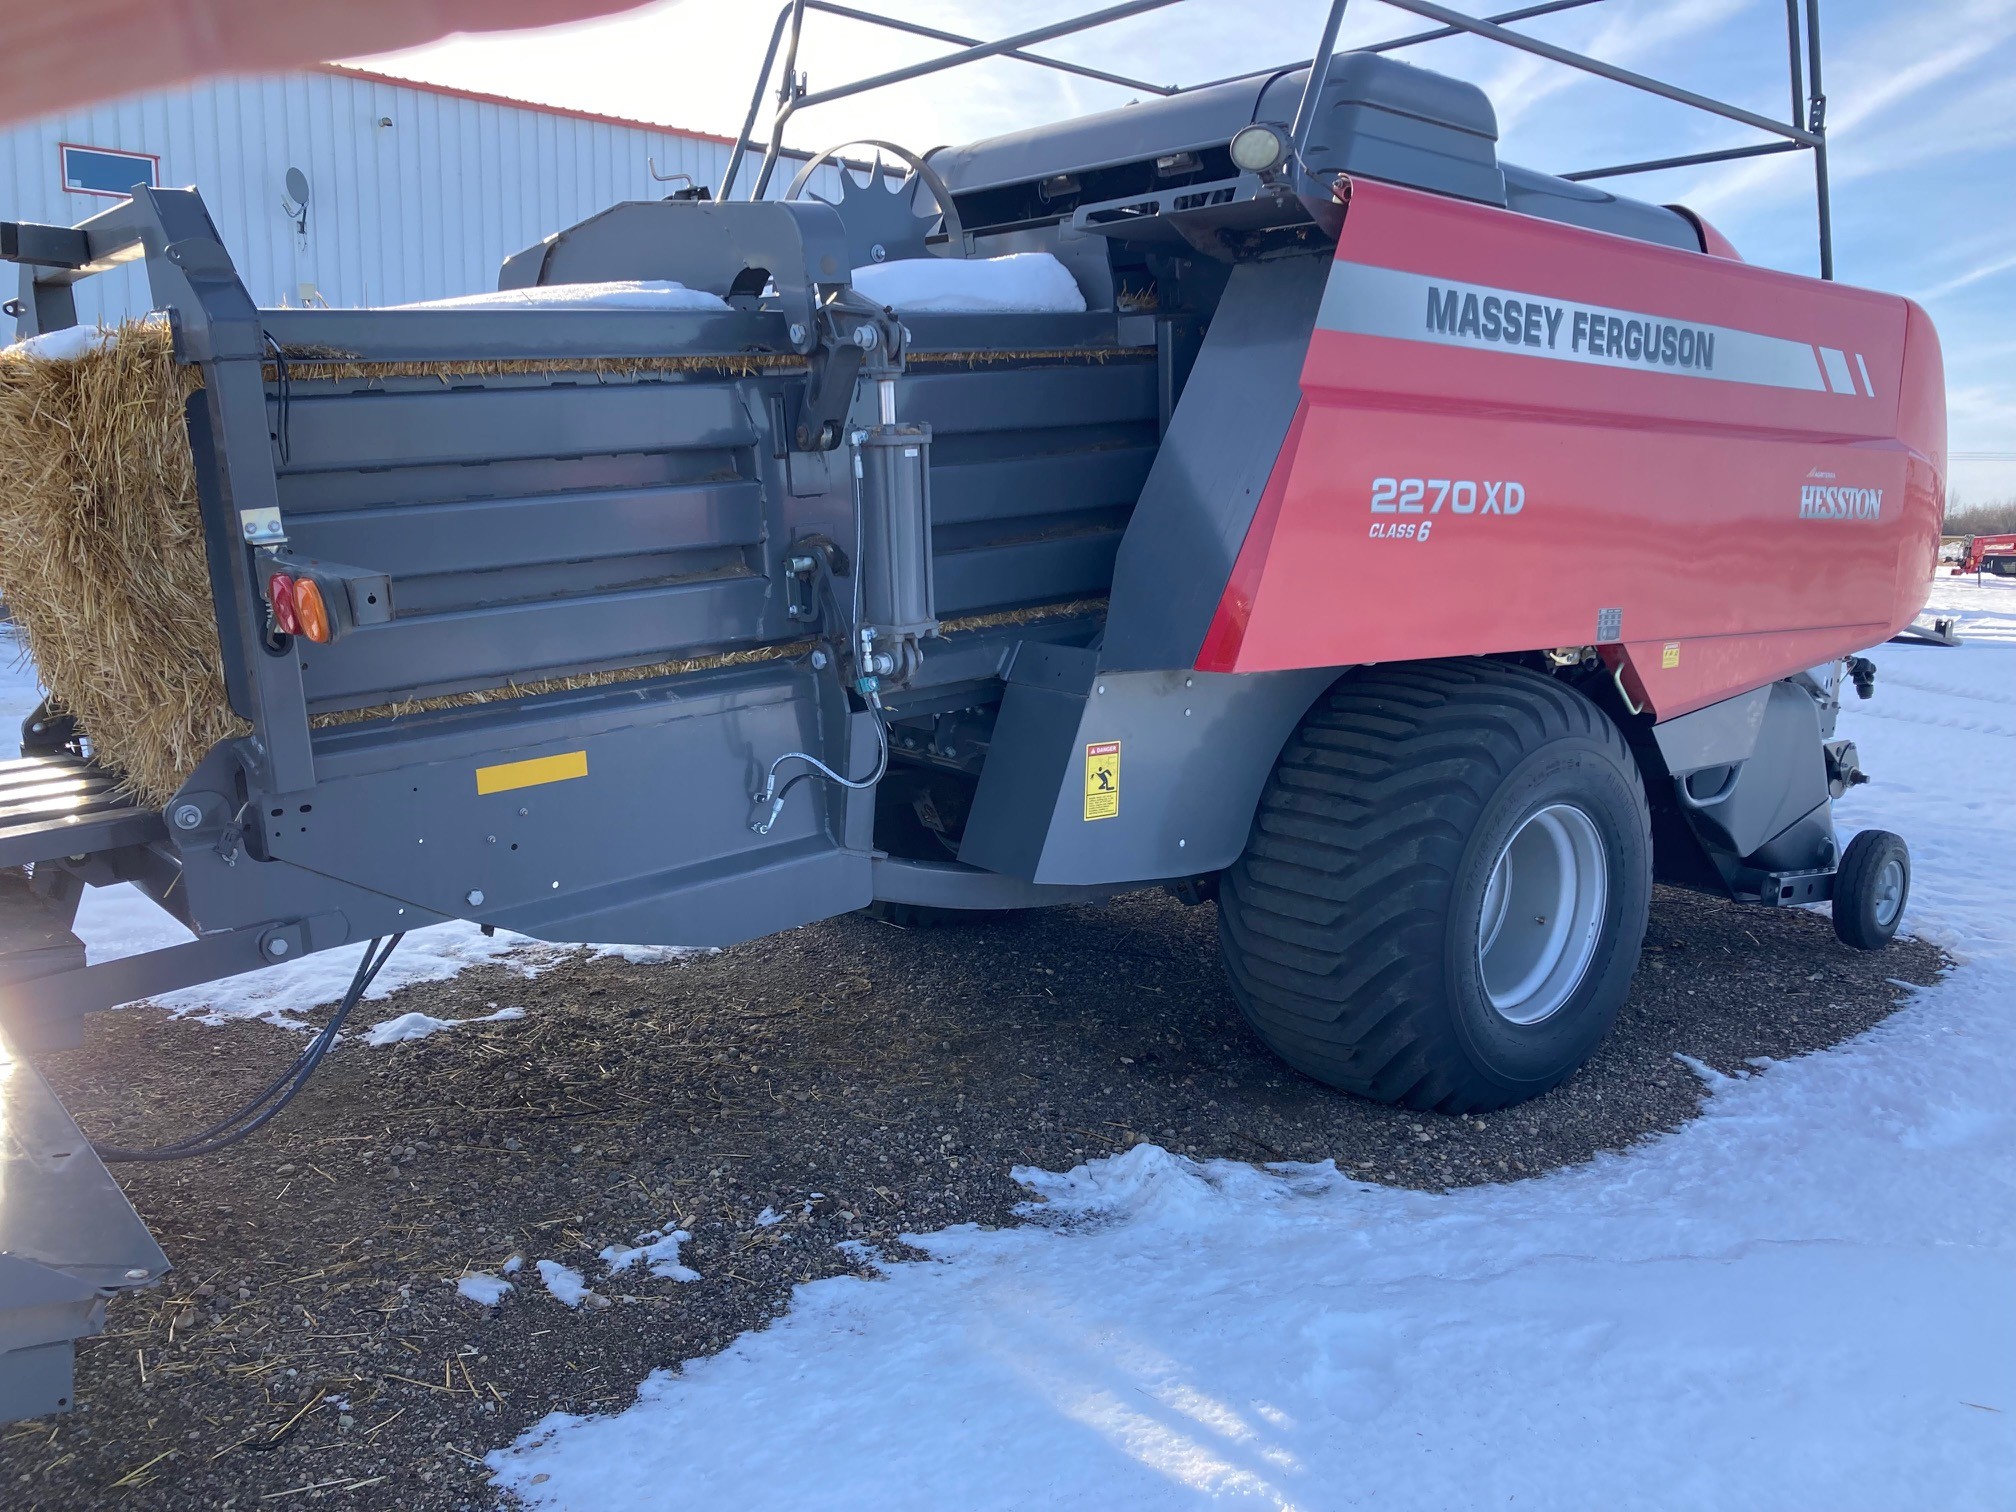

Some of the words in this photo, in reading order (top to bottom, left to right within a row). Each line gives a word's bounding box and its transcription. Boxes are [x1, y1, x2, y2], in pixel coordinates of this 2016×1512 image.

[1426, 286, 1562, 350] MASSEY
[1571, 311, 1714, 370] FERGUSON
[1799, 485, 1883, 520] HESSTON
[1369, 522, 1416, 538] CLASS
[1416, 520, 1433, 542] 6
